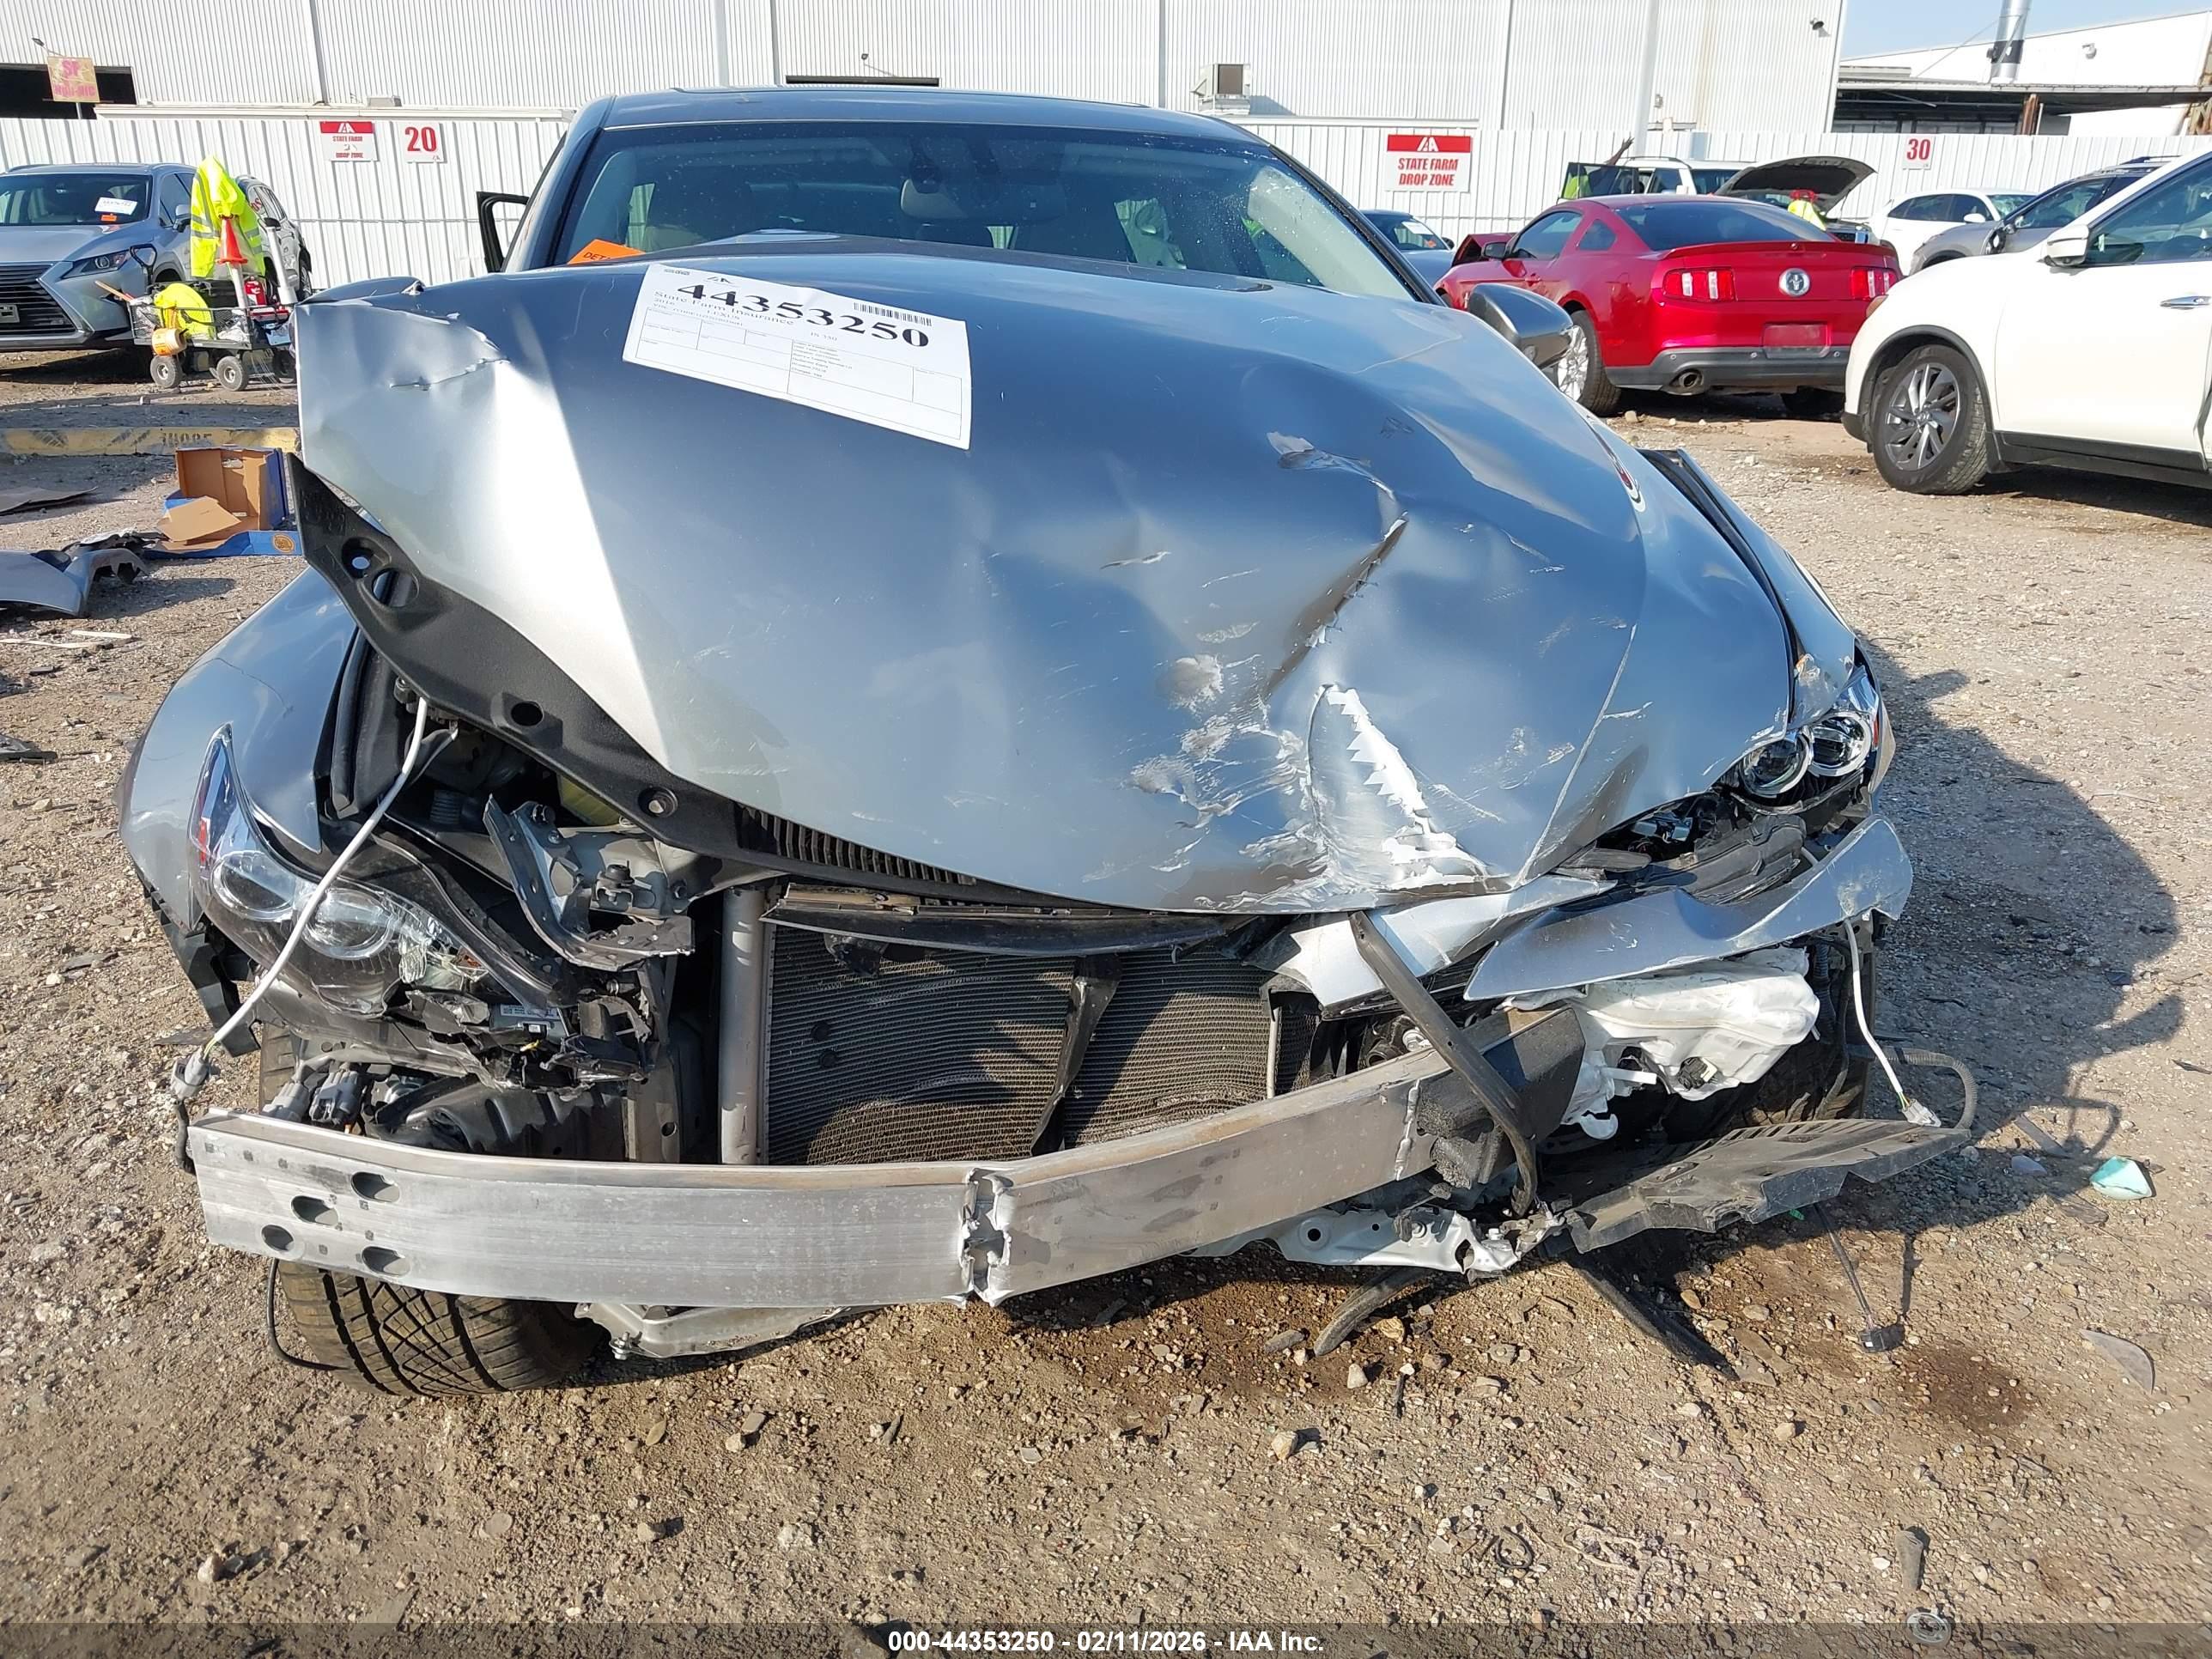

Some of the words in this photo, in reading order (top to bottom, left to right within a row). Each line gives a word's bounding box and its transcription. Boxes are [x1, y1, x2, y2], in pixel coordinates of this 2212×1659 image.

[405, 126, 437, 152] 20
[1906, 138, 1931, 161] 30
[1398, 157, 1429, 171] STATE
[1430, 158, 1459, 171] FARM
[1399, 173, 1427, 185] DROP
[1429, 173, 1455, 186] ZONE
[654, 290, 687, 303] State
[692, 299, 726, 312] Farm
[732, 307, 794, 325] Insurance
[677, 284, 929, 347] 44353250
